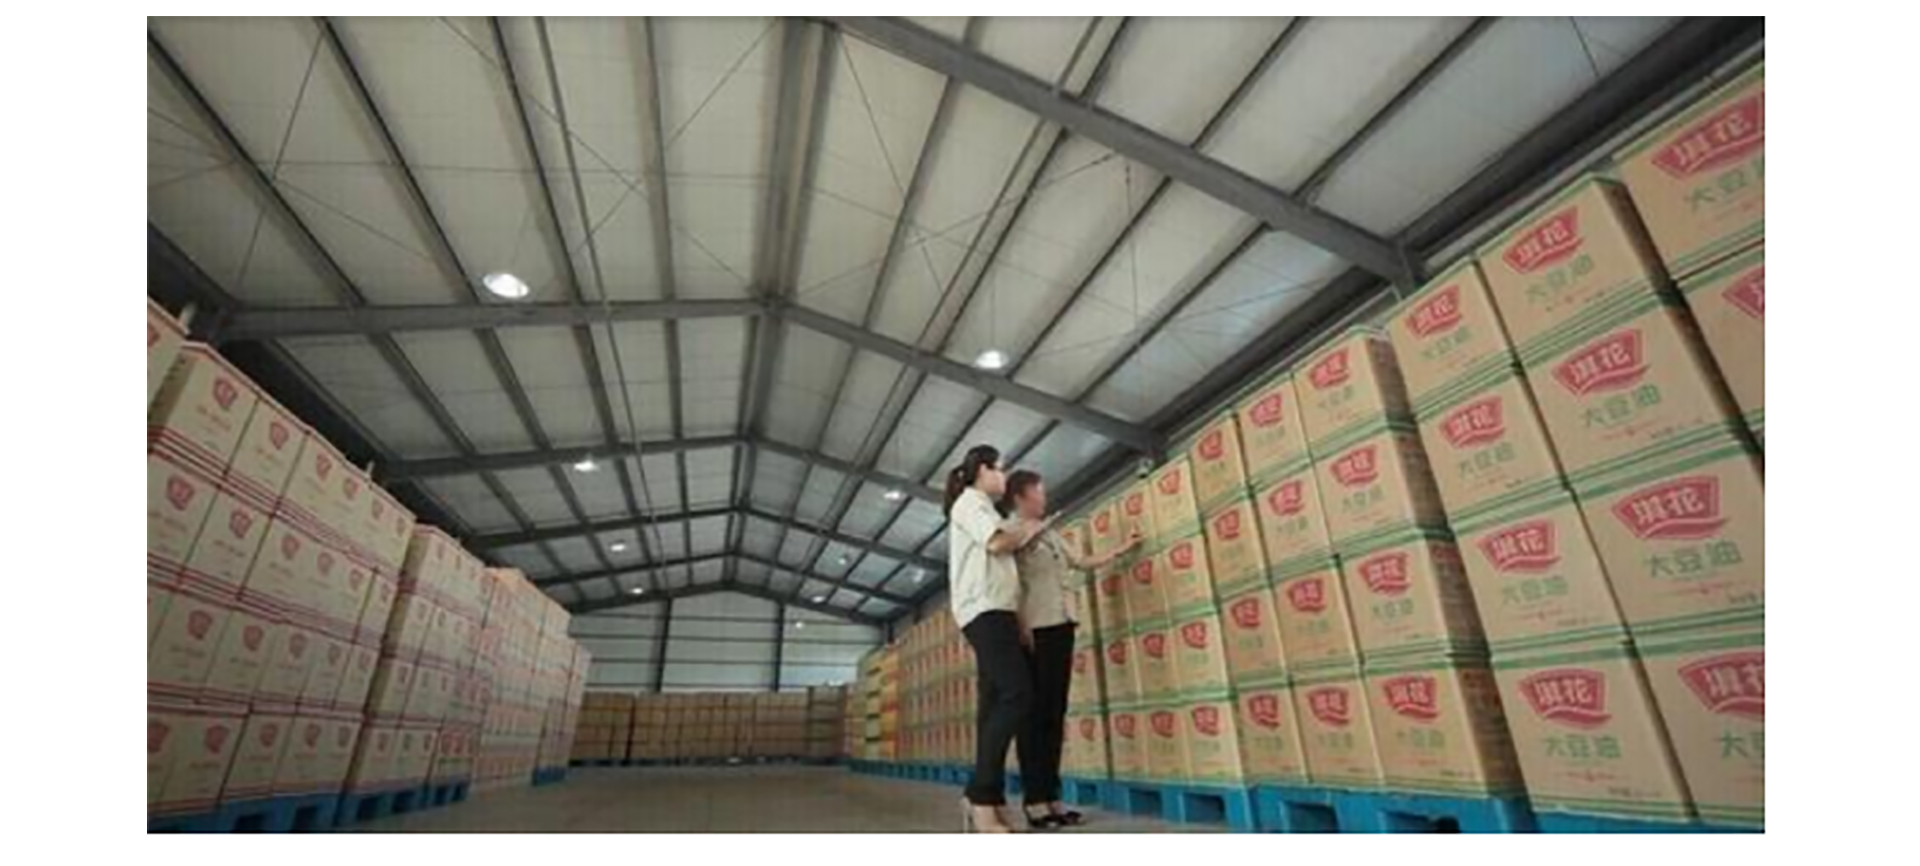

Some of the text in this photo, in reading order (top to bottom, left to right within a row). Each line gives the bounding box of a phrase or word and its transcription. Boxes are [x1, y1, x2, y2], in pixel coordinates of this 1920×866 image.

[1643, 540, 1744, 579] 大豆油
[1544, 734, 1622, 765] 大豆油
